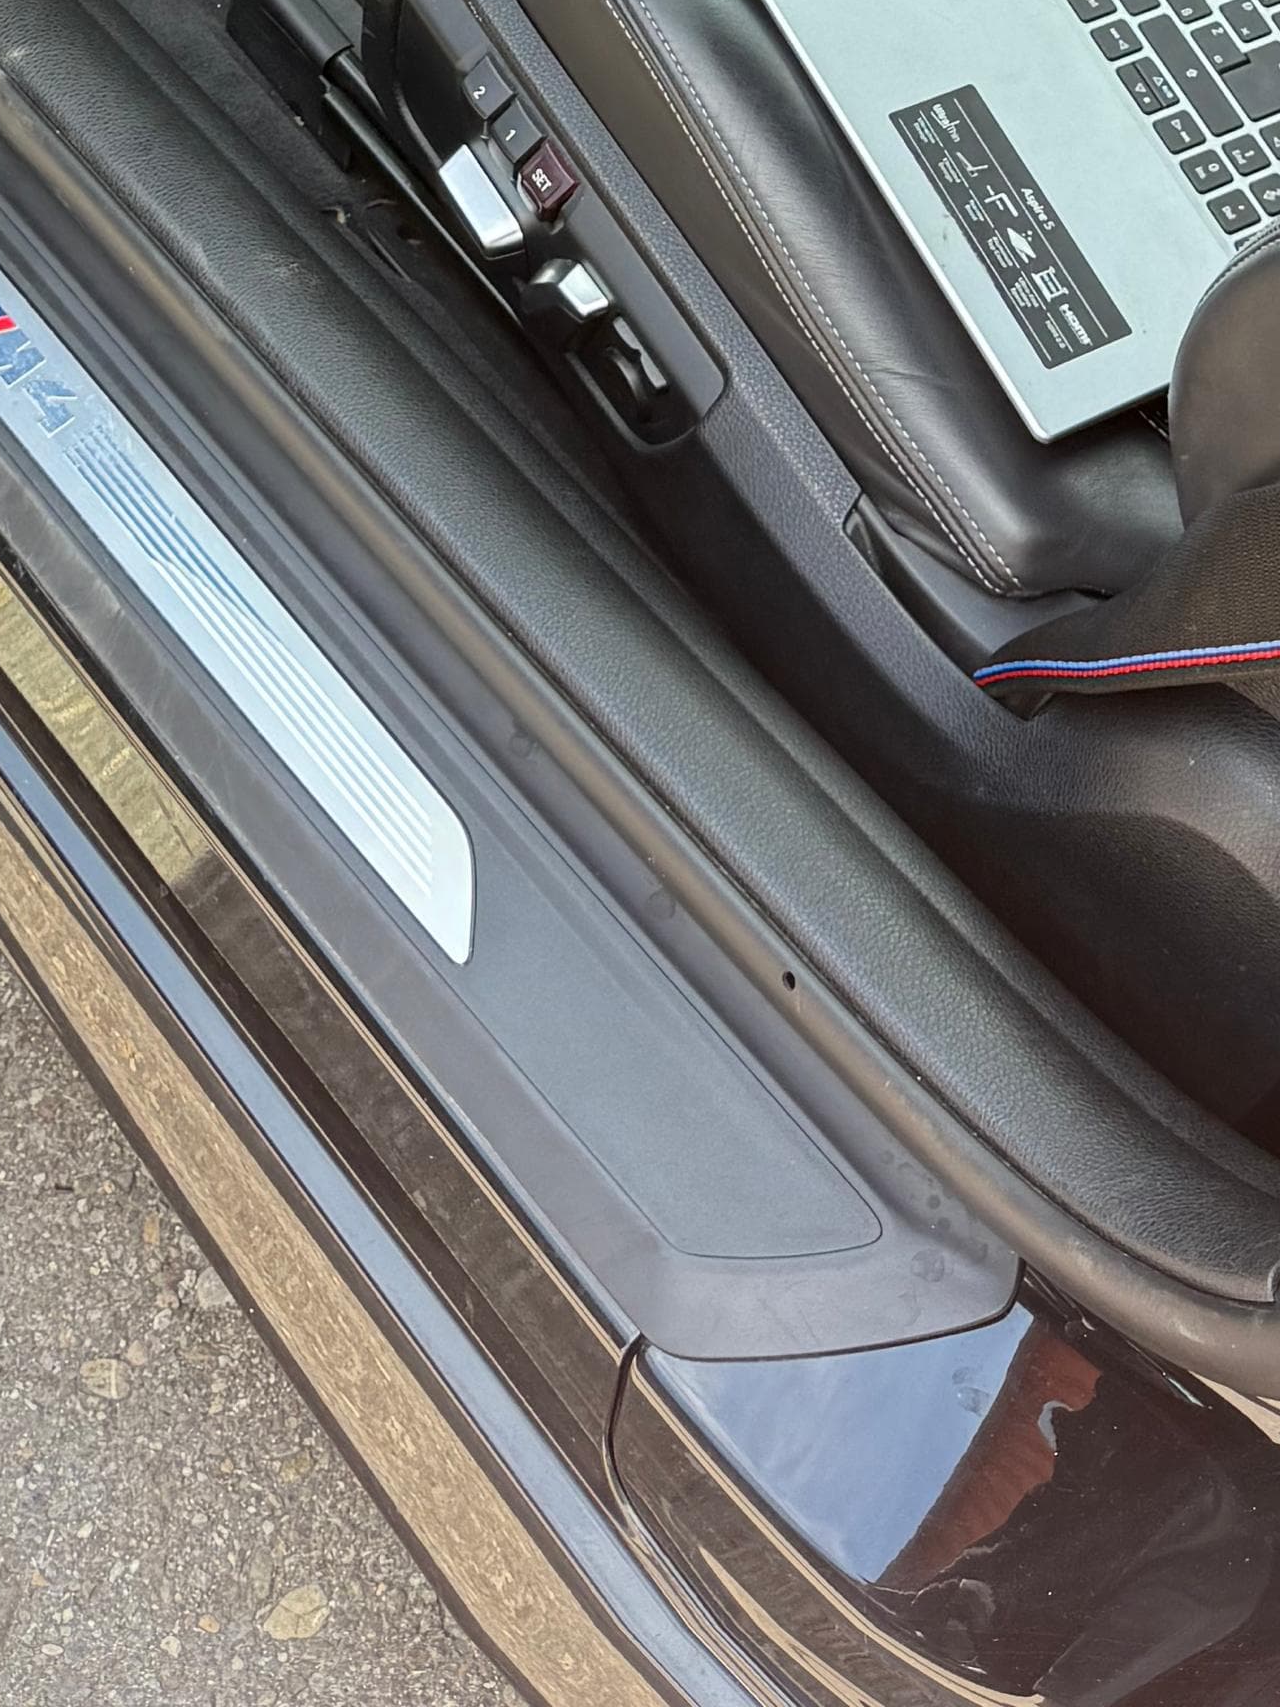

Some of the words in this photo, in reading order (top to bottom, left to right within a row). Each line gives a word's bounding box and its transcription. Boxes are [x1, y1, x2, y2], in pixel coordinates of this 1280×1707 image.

[472, 85, 486, 100] 2
[505, 129, 516, 142] 1
[1207, 162, 1220, 173] 0
[531, 168, 552, 192] SET
[1021, 188, 1048, 221] Aspire
[1042, 220, 1056, 231] 5
